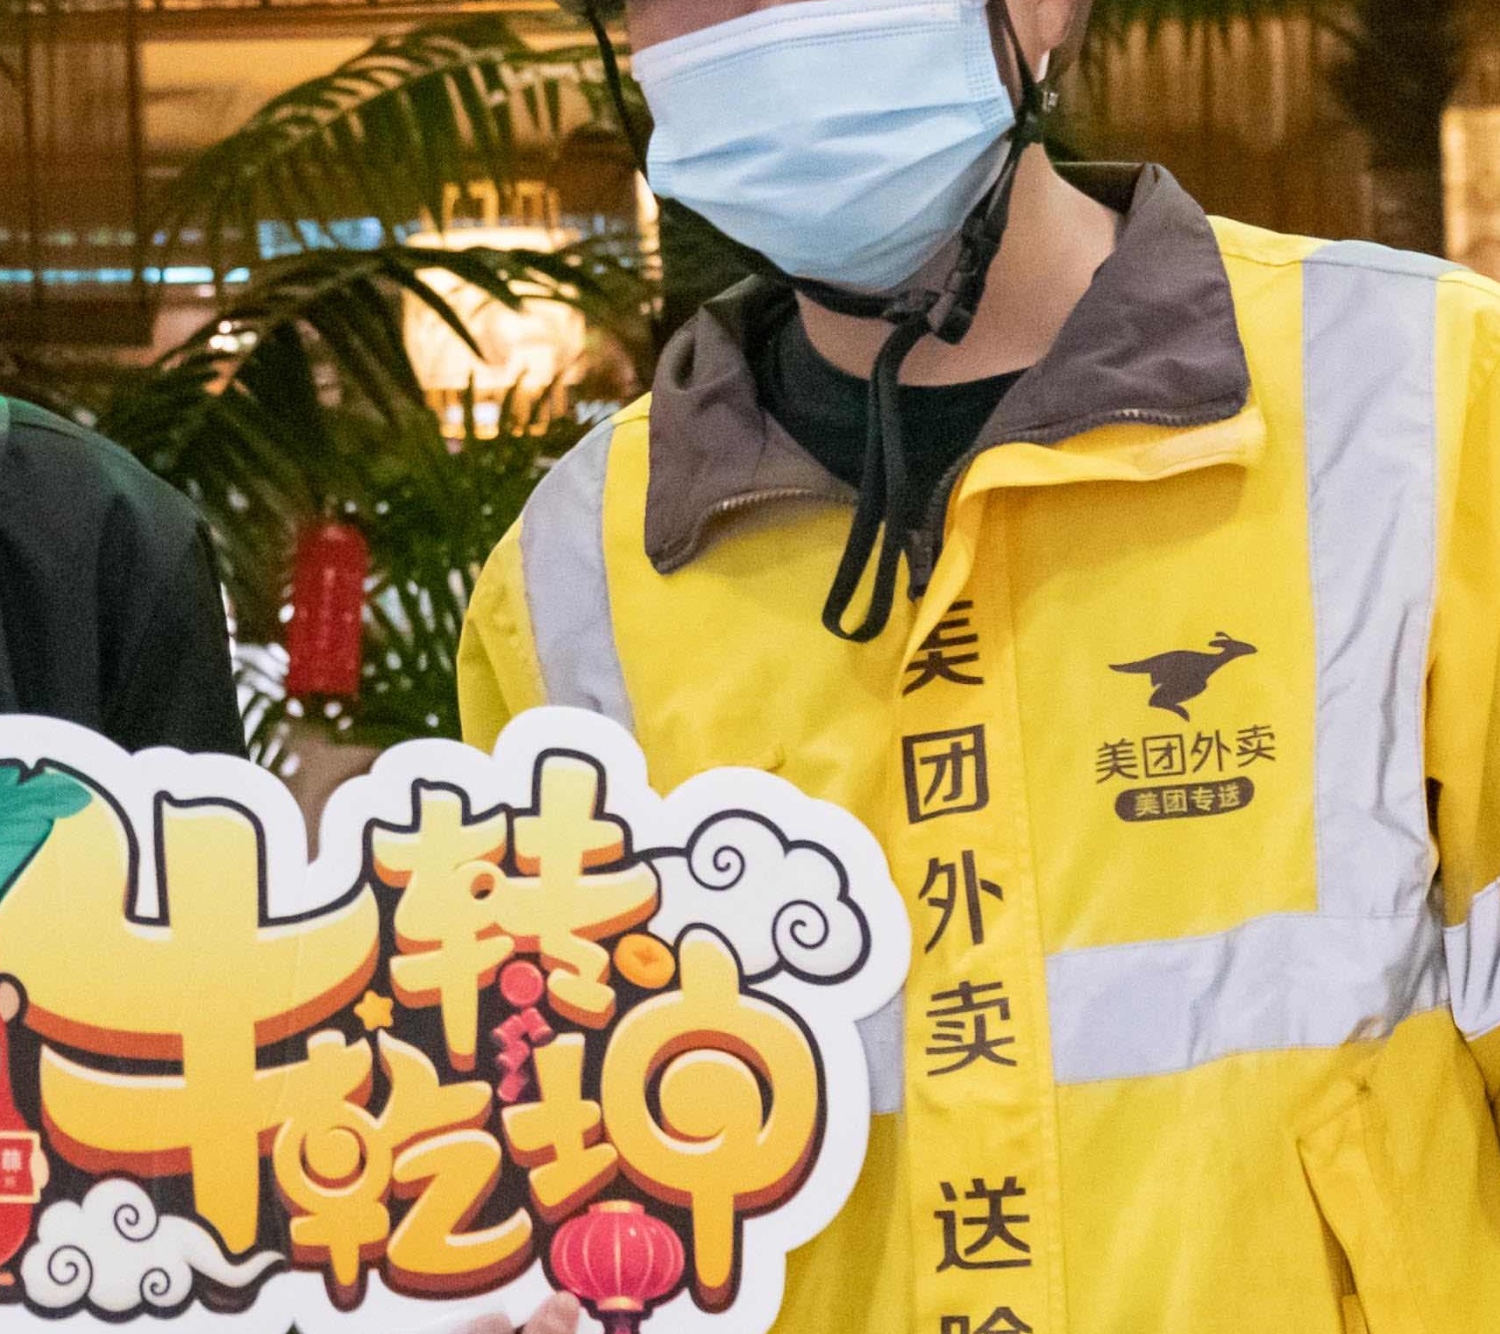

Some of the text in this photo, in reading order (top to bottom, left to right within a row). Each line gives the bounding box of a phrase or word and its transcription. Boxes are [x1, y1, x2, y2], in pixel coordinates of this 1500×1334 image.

[1095, 724, 1276, 785] 美团外卖
[1135, 782, 1242, 817] 美团专送
